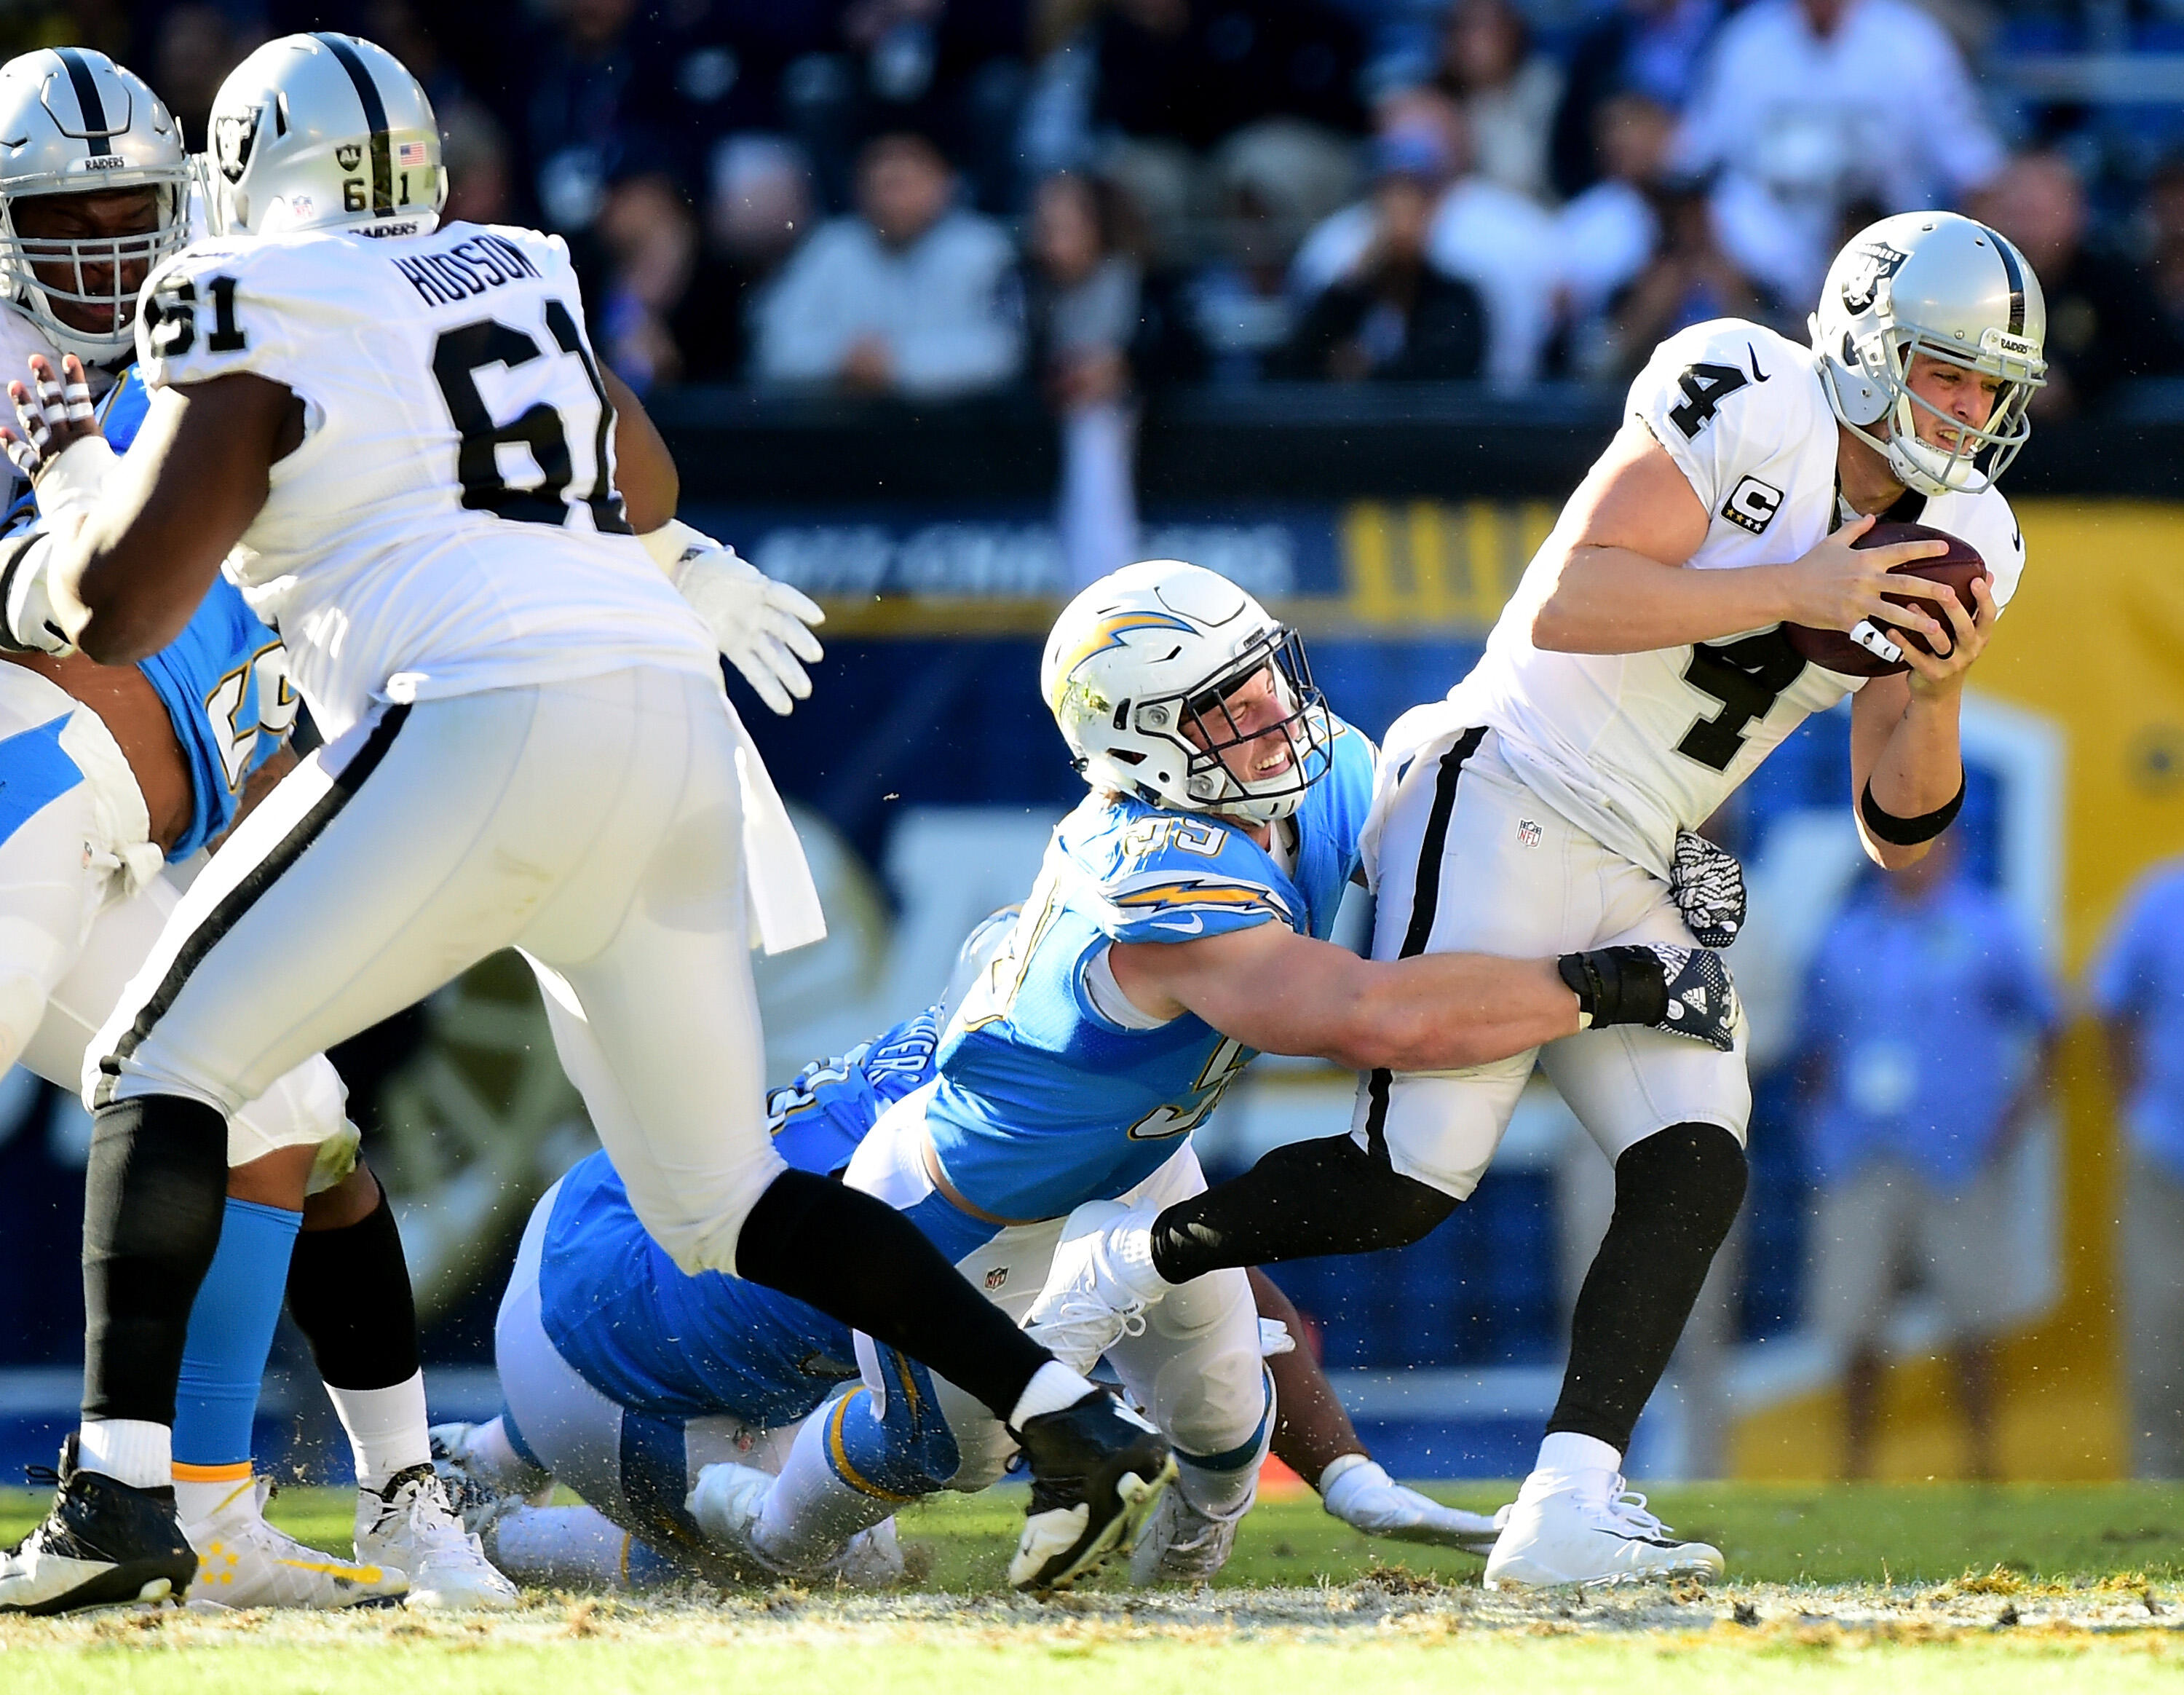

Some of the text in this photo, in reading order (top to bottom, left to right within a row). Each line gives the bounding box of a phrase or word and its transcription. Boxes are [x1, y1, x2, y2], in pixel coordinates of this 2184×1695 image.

[85, 157, 124, 170] RAIDERS
[392, 234, 542, 307] HUDSON
[2001, 338, 2028, 355] RAIDERS
[432, 299, 635, 537] 61
[1669, 363, 1750, 443] 4
[1731, 479, 1781, 523] C
[1671, 620, 1810, 776] 4
[1682, 992, 1708, 1015] adidas
